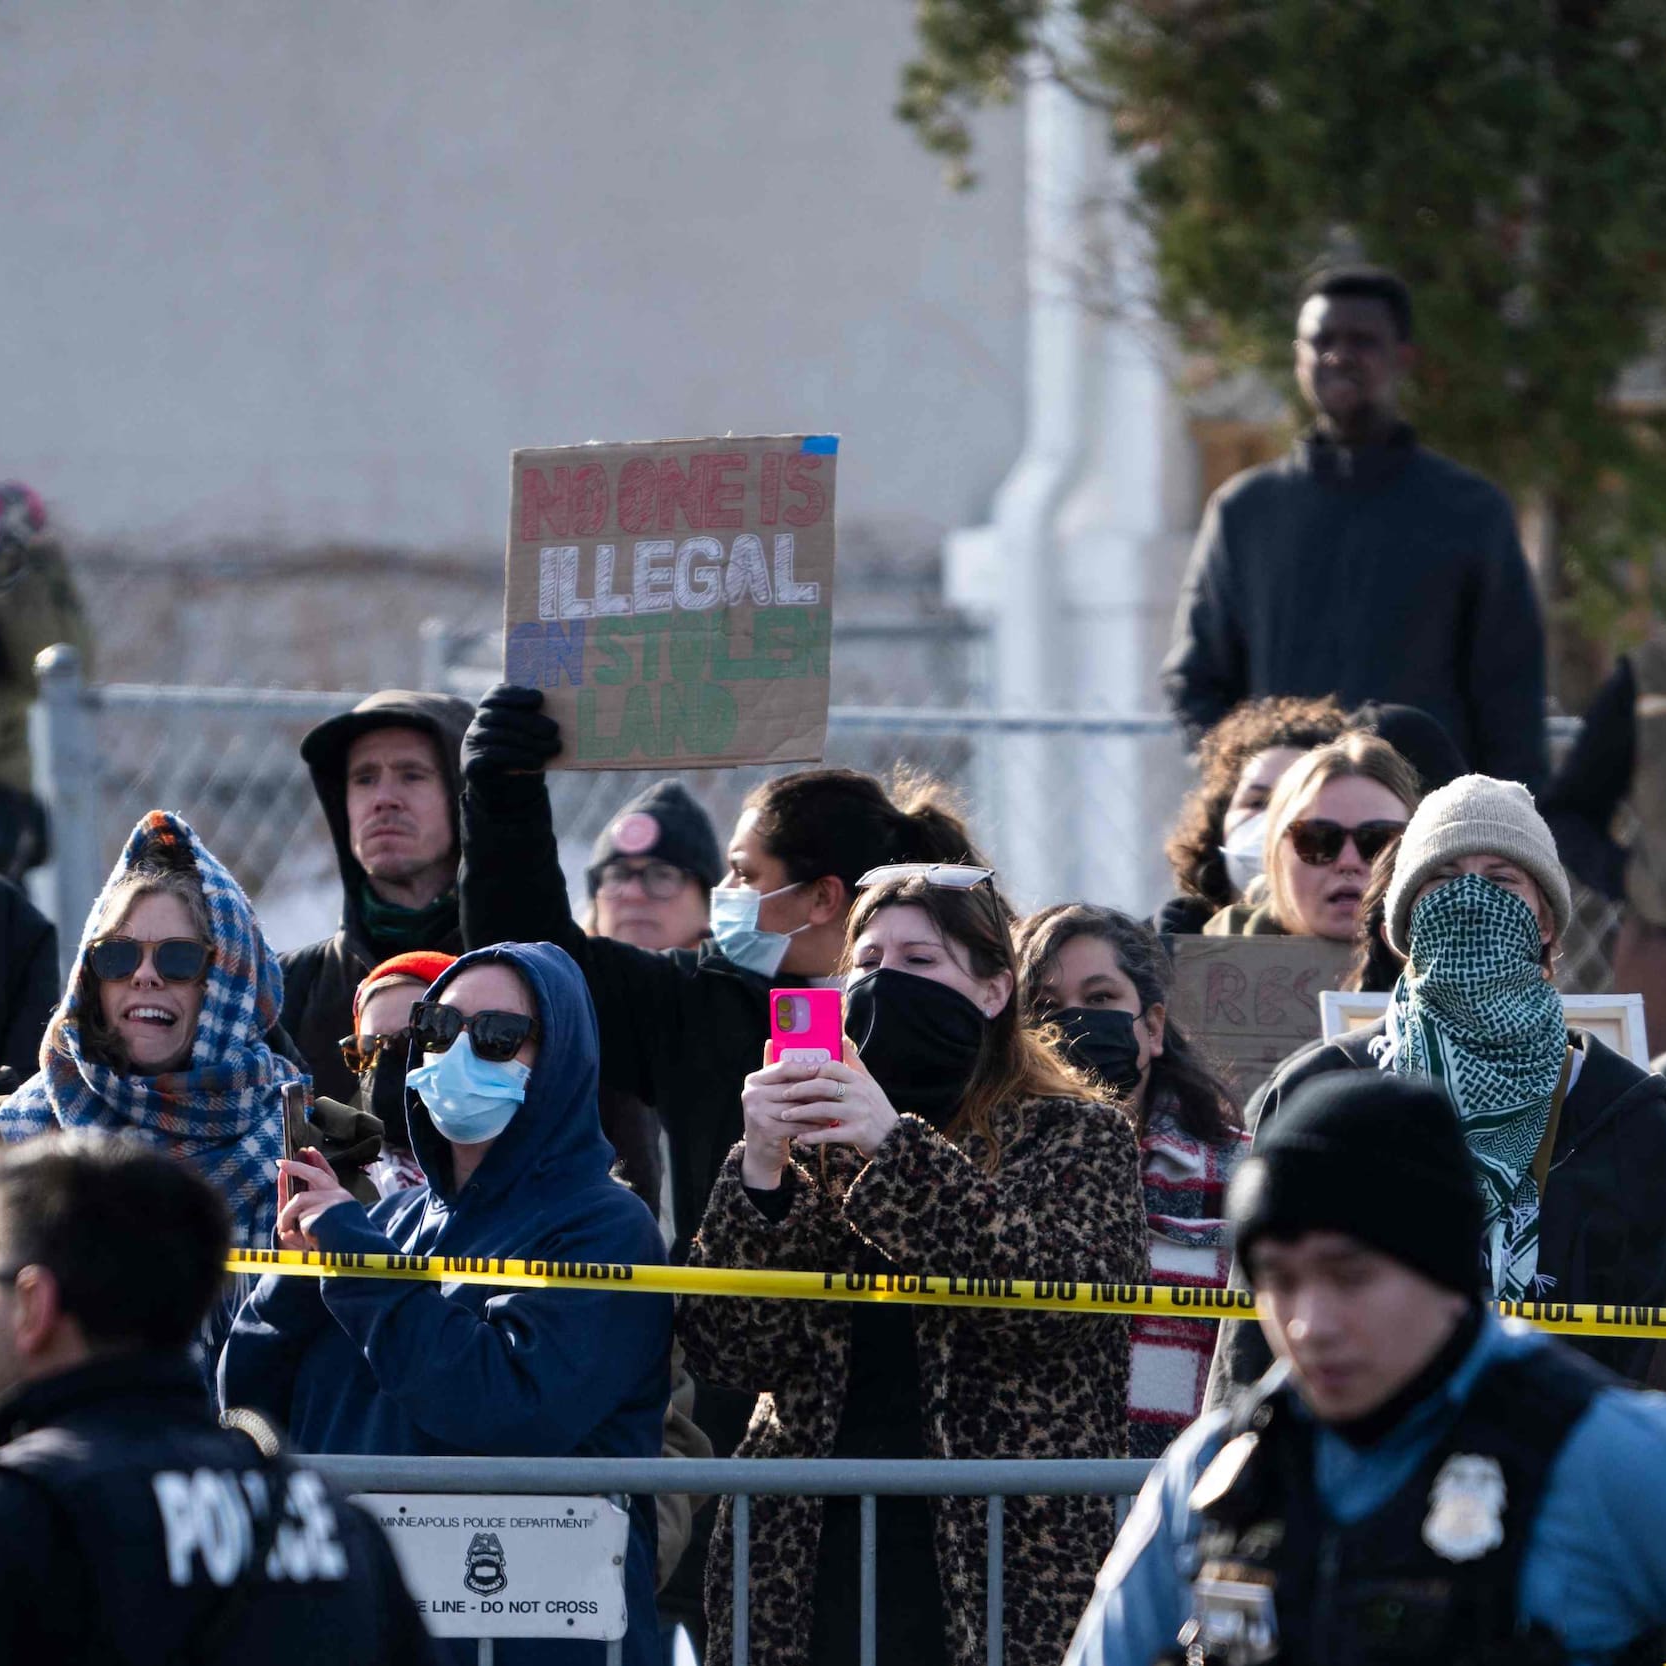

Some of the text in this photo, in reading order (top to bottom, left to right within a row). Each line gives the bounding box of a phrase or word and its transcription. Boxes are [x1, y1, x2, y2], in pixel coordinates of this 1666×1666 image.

[522, 452, 826, 542] NO ONE IS
[539, 533, 819, 620] ILLEGAL
[507, 608, 830, 688] ON STOLEN
[577, 683, 737, 759] LAND
[1205, 960, 1323, 1039] RES
[379, 1517, 589, 1529] MINNEAPOLIS POLICE DEPARTMENT
[432, 1601, 466, 1614] LINE
[481, 1601, 504, 1614] DO
[509, 1601, 541, 1614] NOT
[545, 1601, 598, 1615] CROSS
